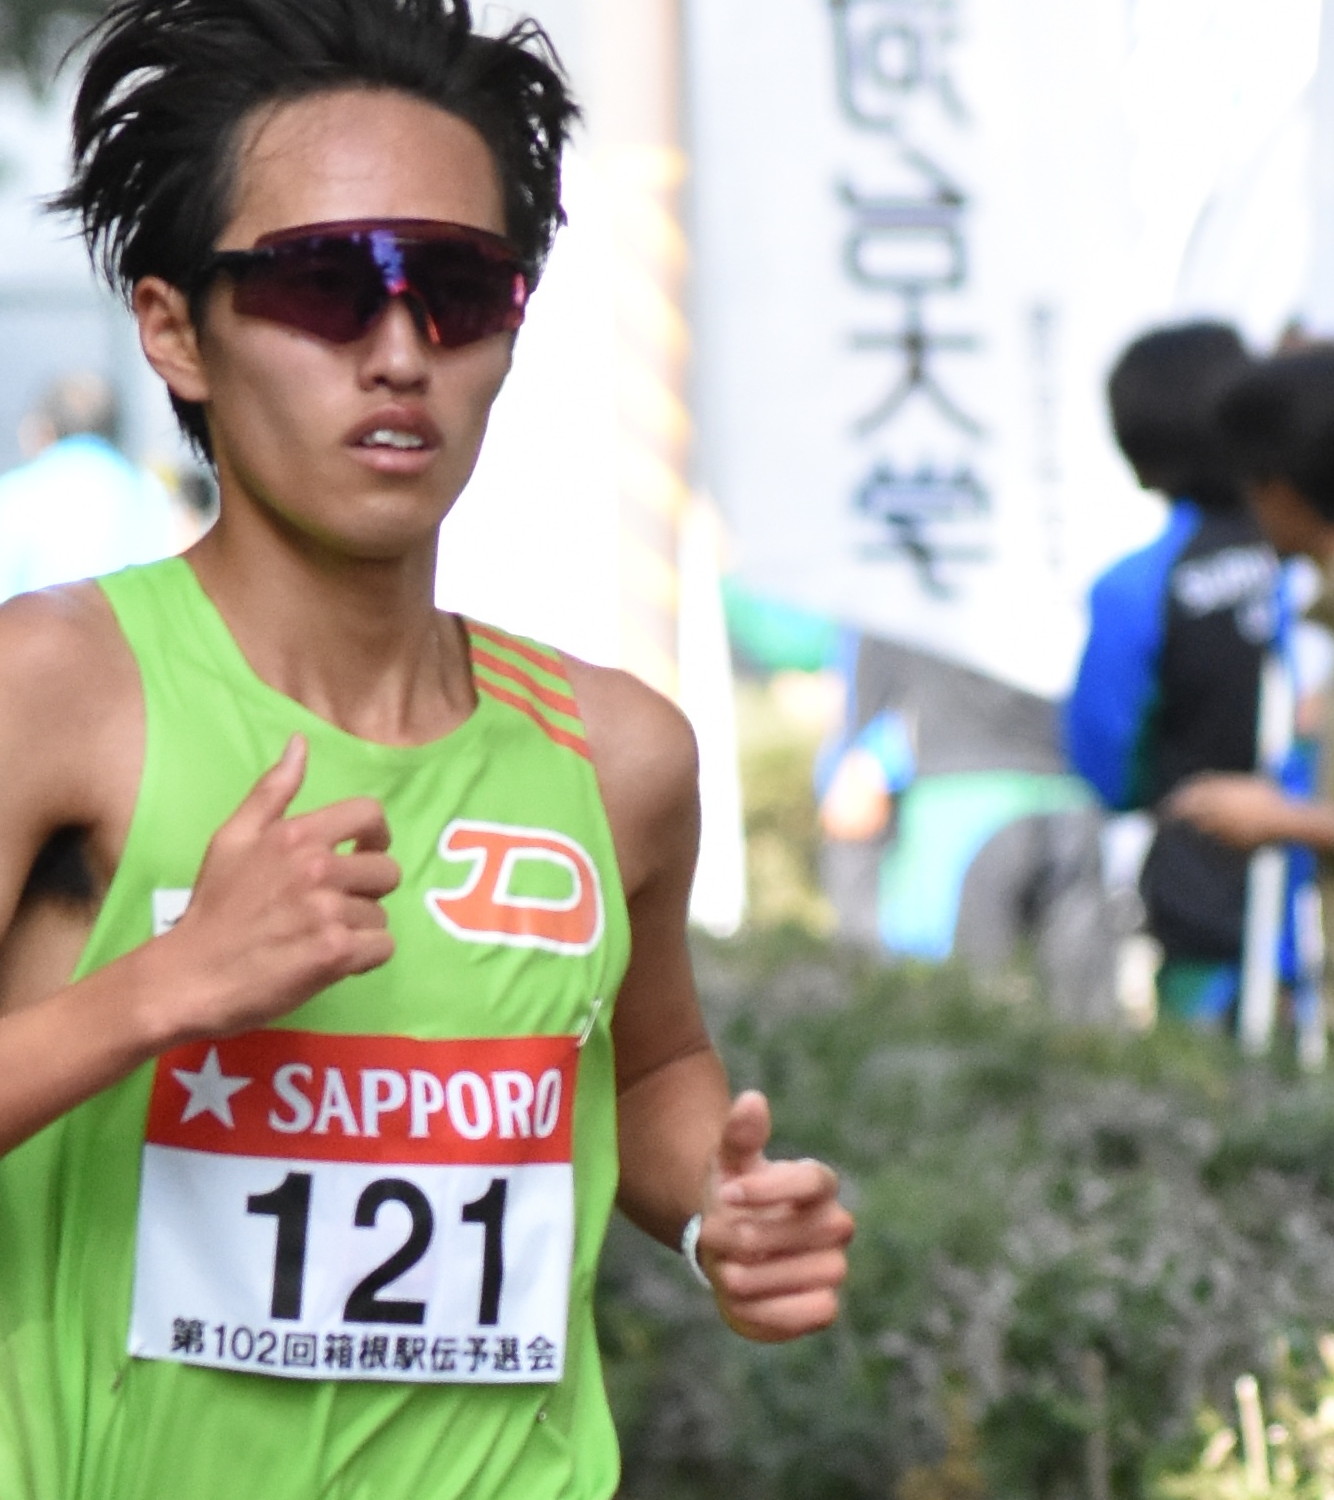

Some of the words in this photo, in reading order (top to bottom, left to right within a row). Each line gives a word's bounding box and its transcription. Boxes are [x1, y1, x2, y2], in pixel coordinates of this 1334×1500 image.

[269, 1063, 562, 1140] SAPPORO
[247, 1172, 509, 1326] 121
[170, 1315, 556, 1372] 第102回箱根駅伝予選会
